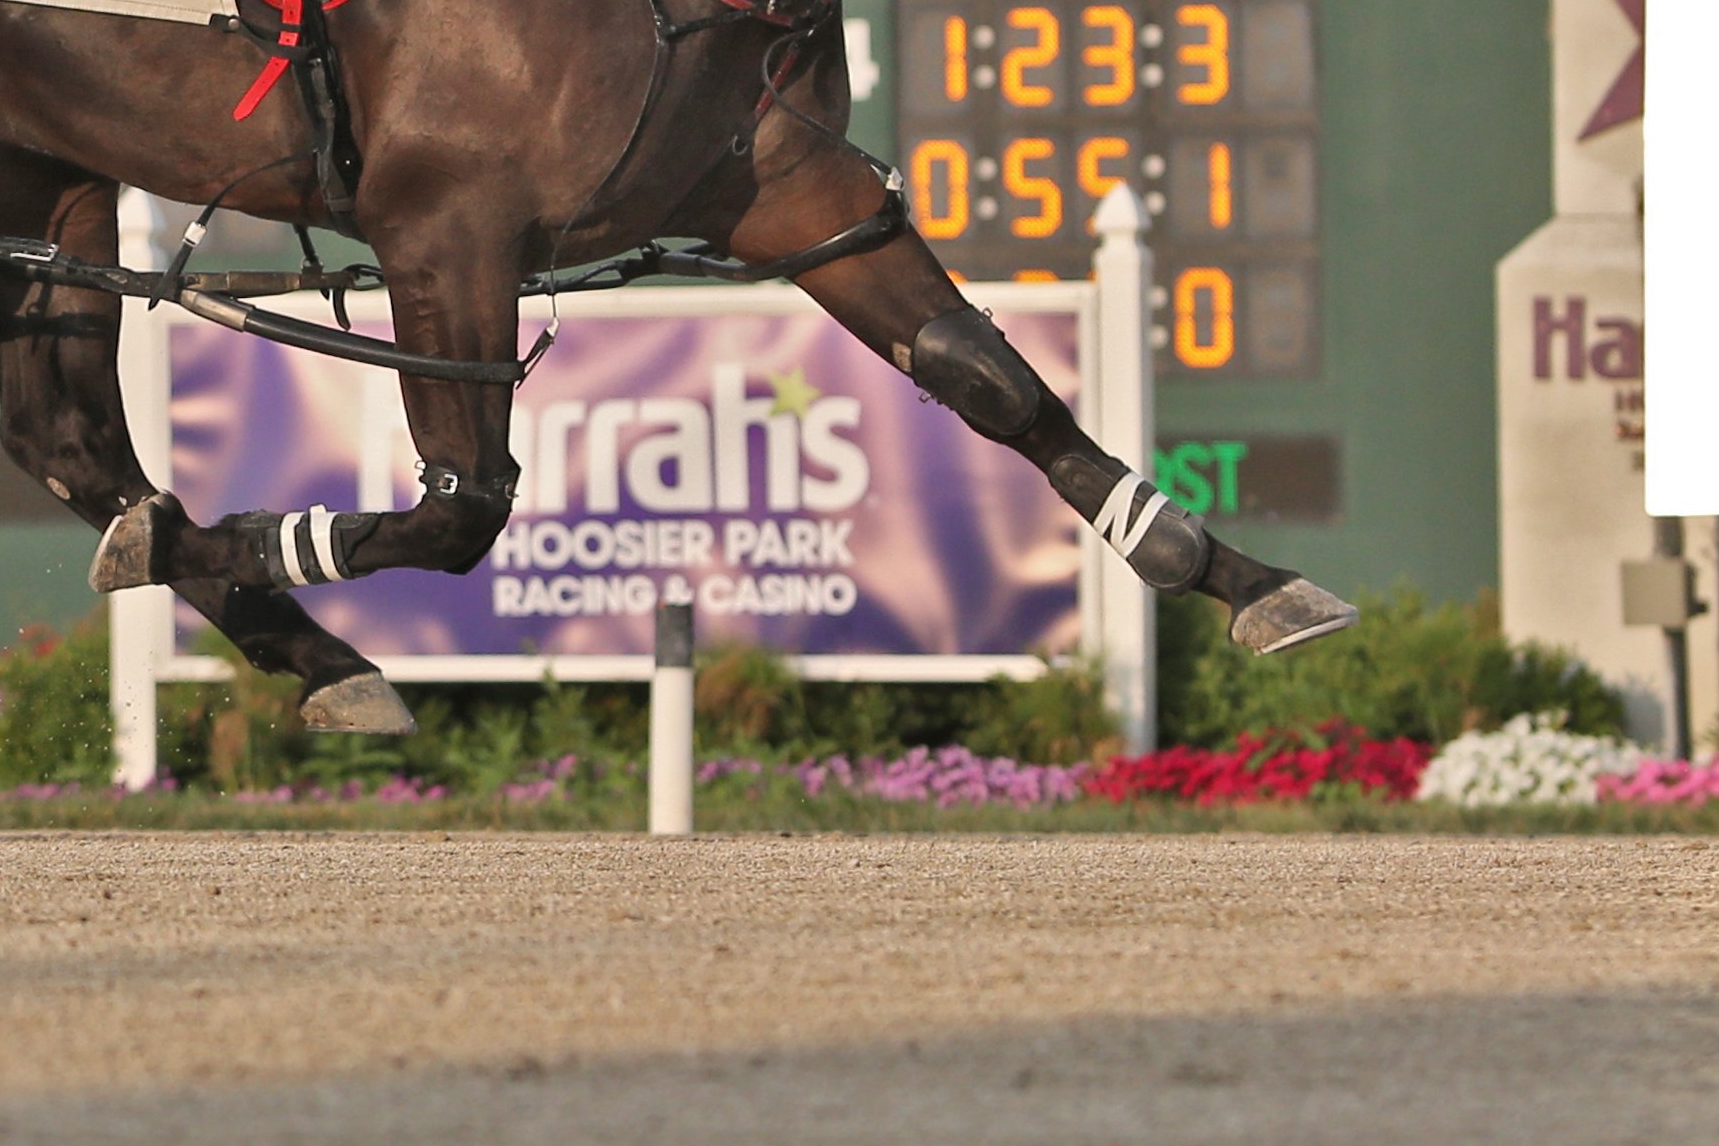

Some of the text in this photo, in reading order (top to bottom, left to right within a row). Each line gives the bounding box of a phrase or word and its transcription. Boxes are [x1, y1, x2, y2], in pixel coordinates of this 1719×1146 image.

[493, 518, 855, 569] HOOSIER PARK
[493, 575, 658, 617] RACING
[698, 573, 858, 615] CASINO
